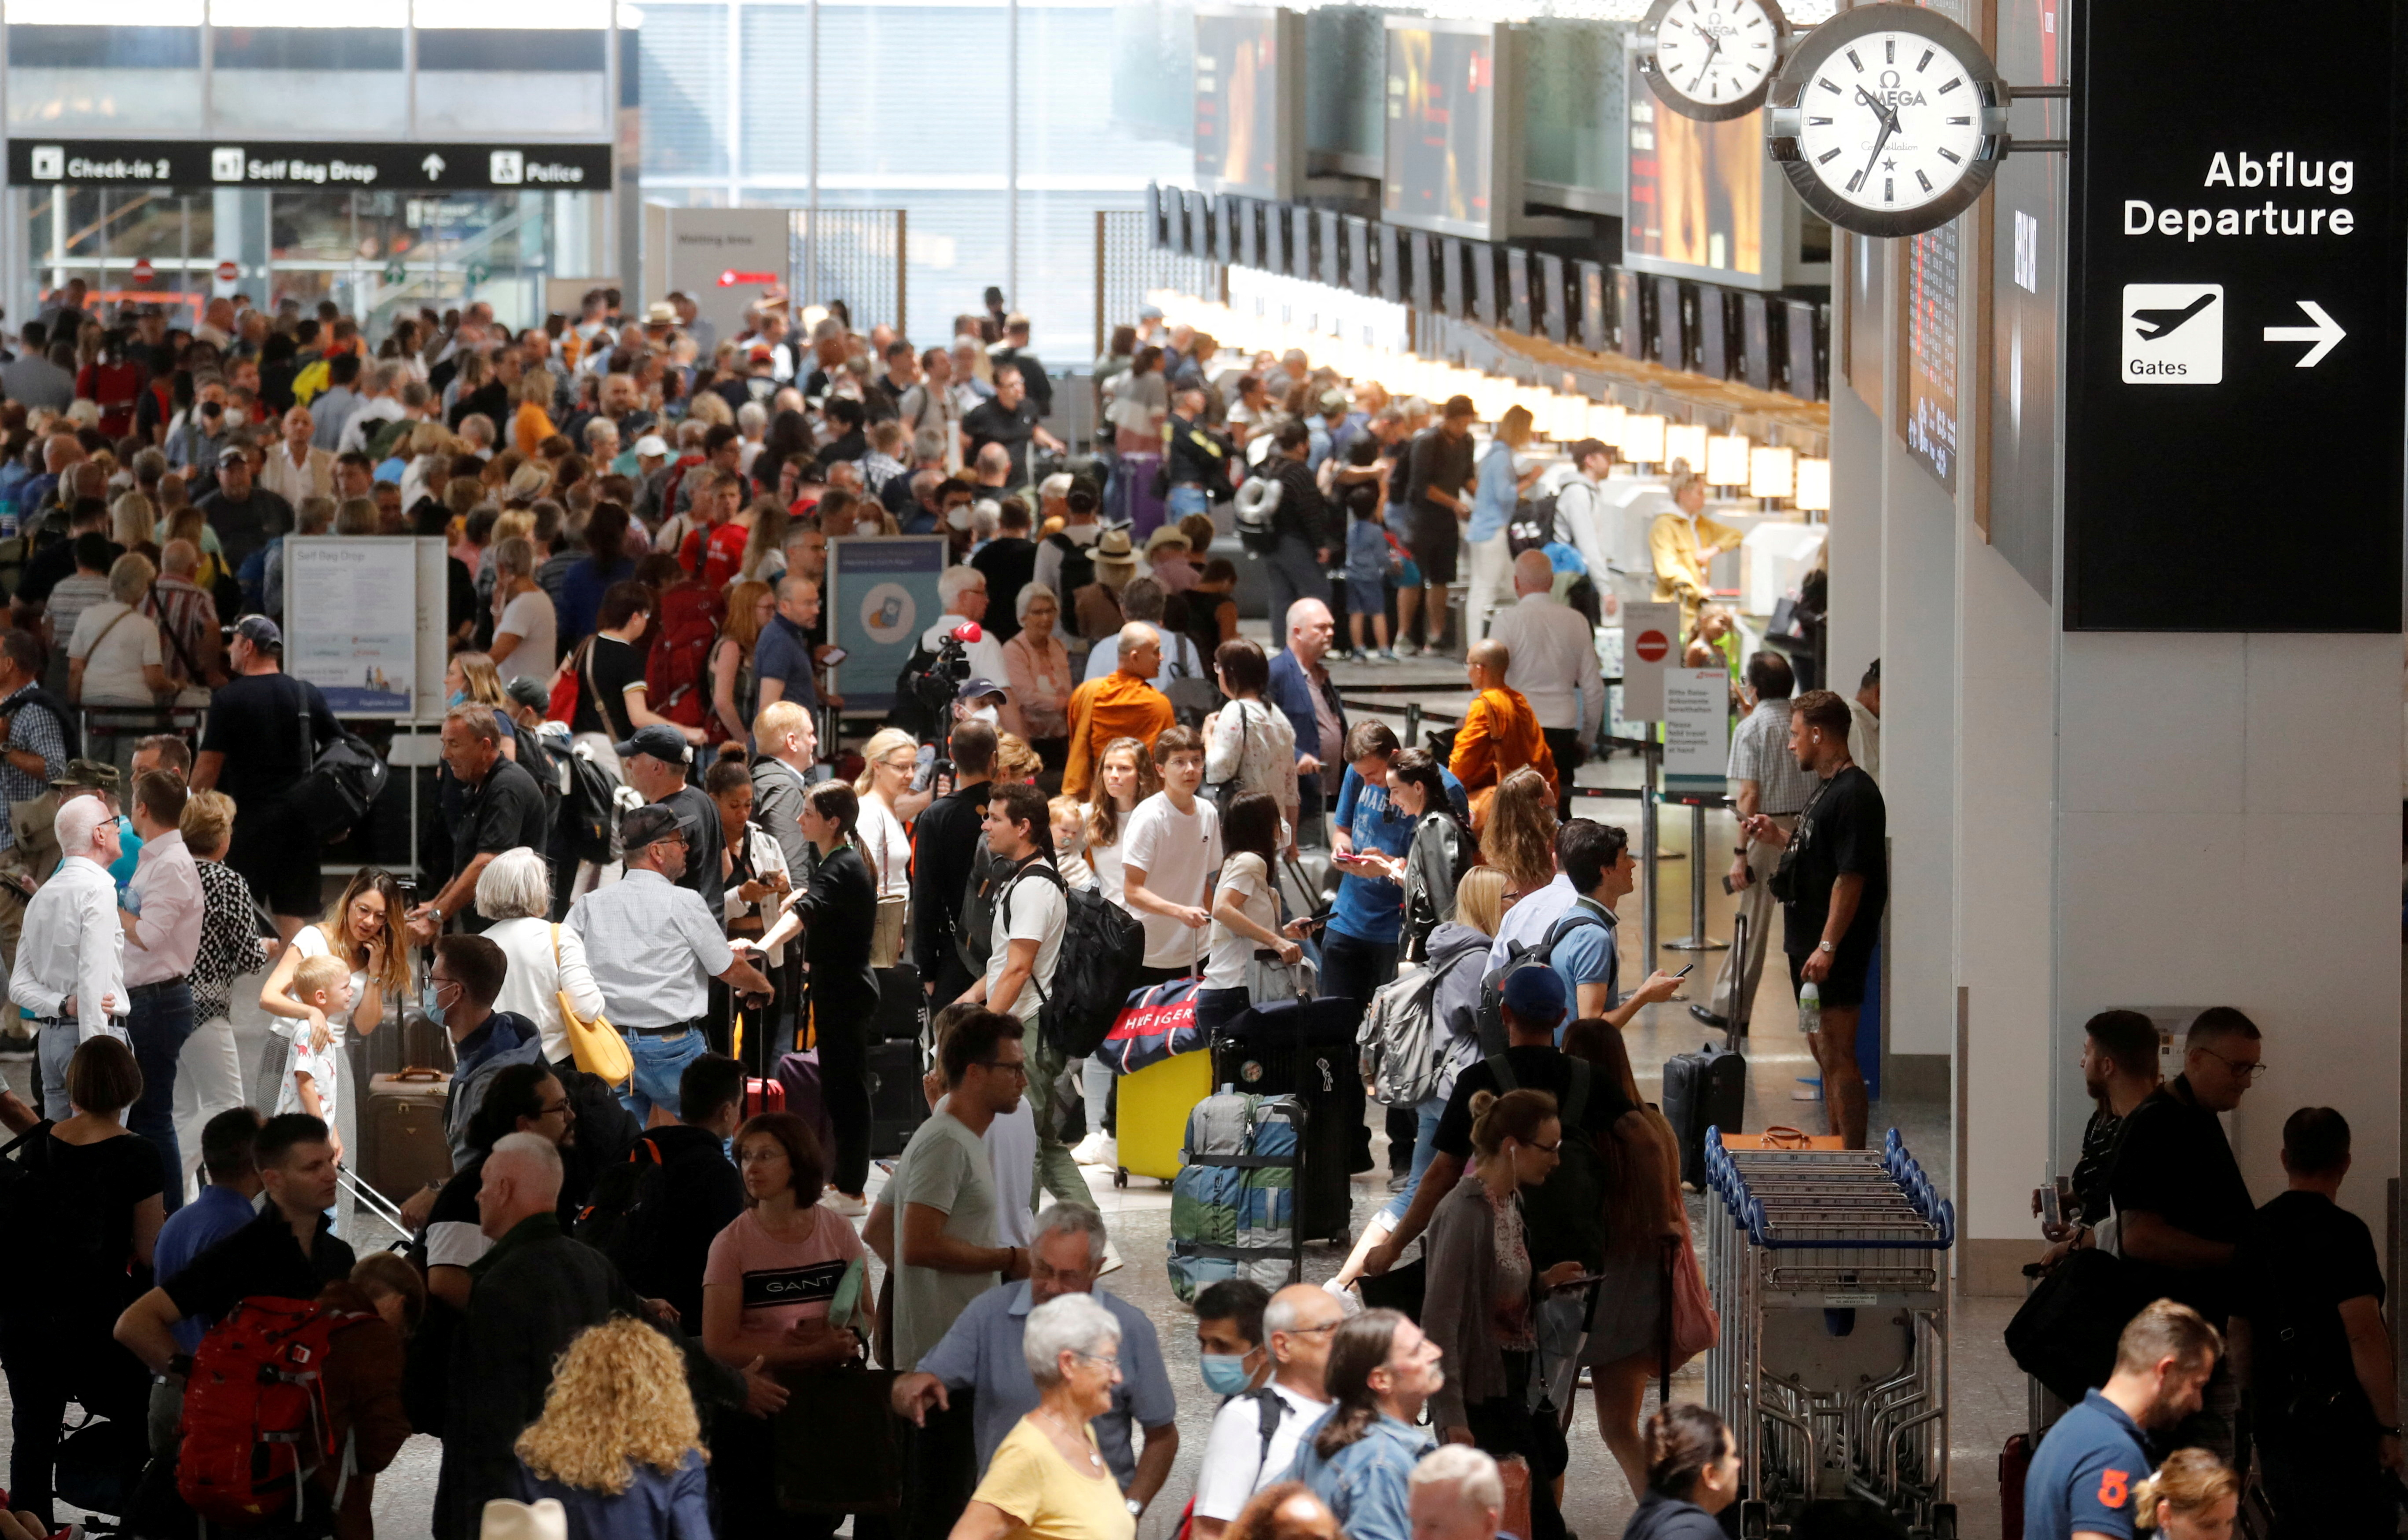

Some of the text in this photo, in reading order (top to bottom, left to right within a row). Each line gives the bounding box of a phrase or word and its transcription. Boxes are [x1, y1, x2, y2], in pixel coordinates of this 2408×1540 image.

[1854, 90, 1927, 106] OMEGA
[1861, 141, 1918, 150] Cotellation
[67, 158, 170, 179] Check-in 2
[248, 160, 377, 183] Self Bag Drop
[526, 163, 584, 182] Police
[2204, 151, 2353, 194] Abflug
[2124, 200, 2354, 242] Departure
[2130, 359, 2187, 375] Gates
[297, 551, 365, 562] Self Bag Drop
[1358, 785, 1408, 819] MADI
[766, 1276, 833, 1292] GANT
[2097, 1468, 2130, 1508] 5
